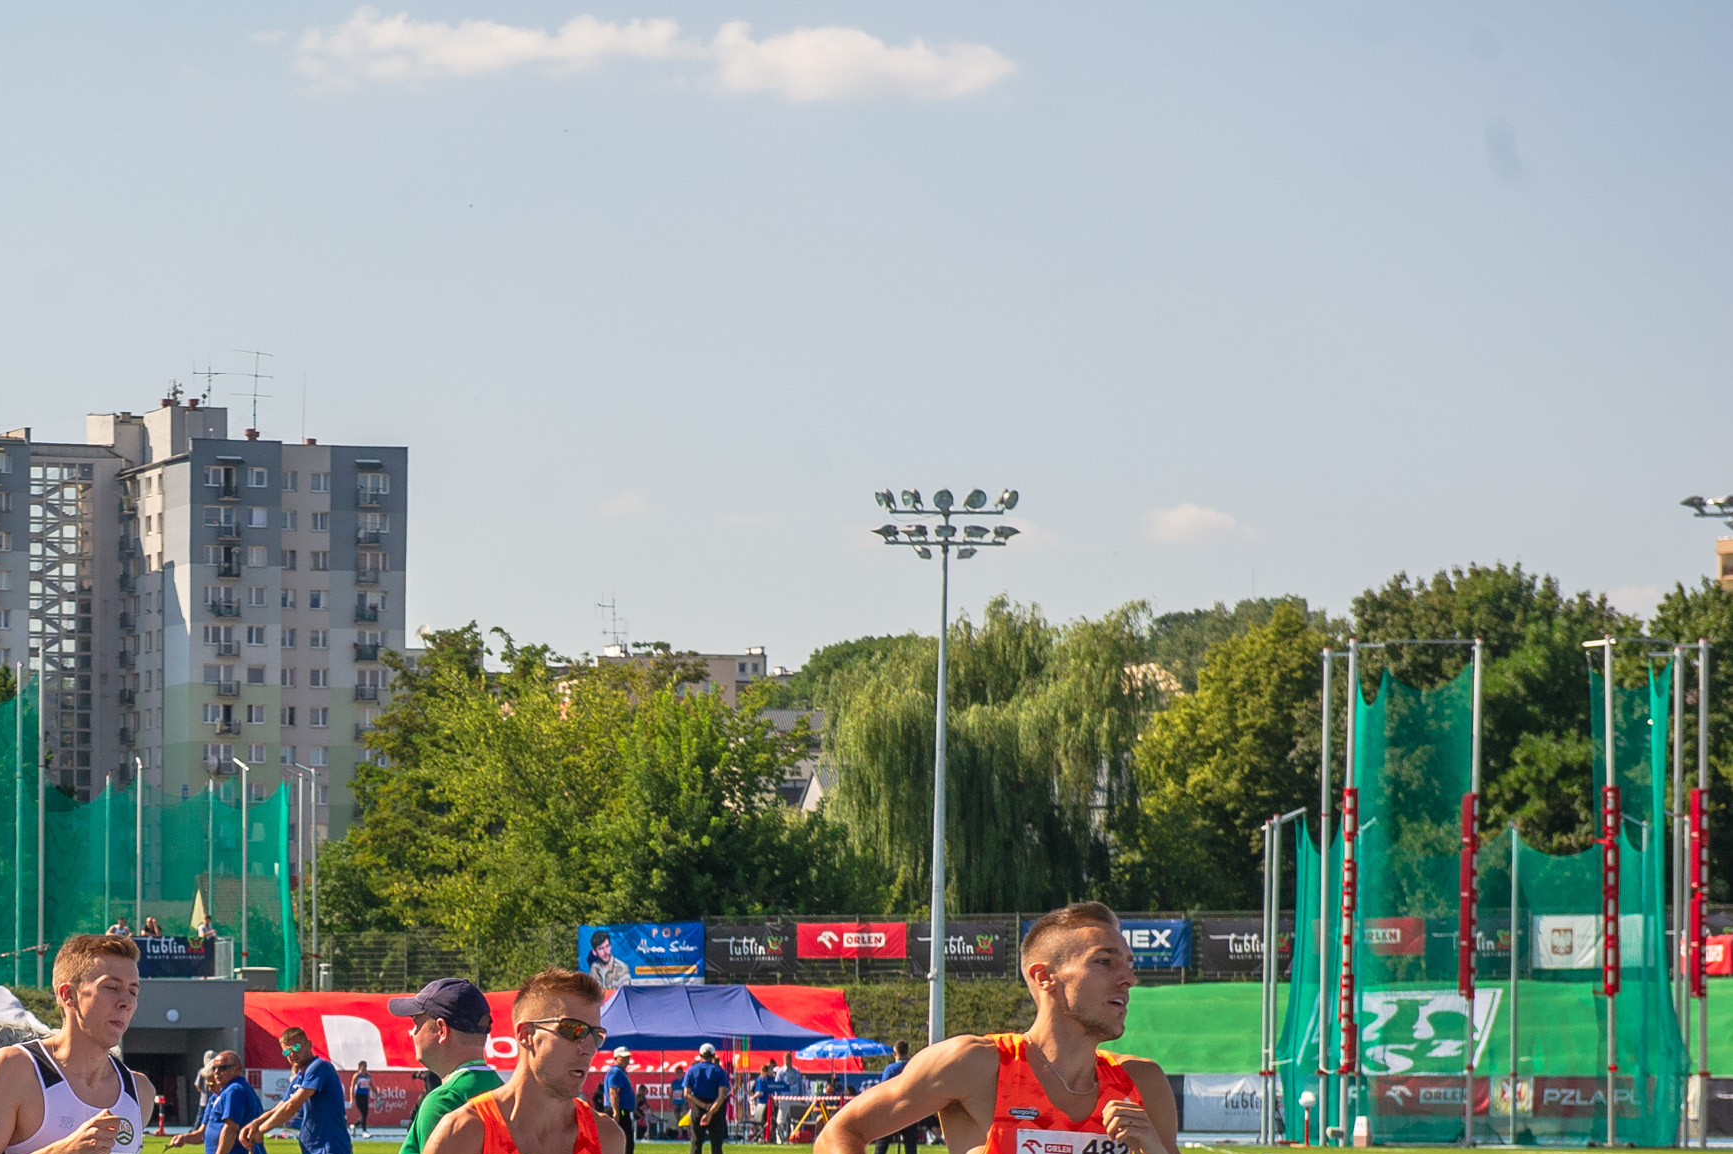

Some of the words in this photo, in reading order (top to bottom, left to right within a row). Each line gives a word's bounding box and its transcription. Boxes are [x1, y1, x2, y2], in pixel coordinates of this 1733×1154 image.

[845, 934, 883, 945] ORLEN
[1367, 930, 1397, 942] RLEN
[146, 936, 186, 954] lublin
[728, 936, 766, 956] lublin
[370, 1087, 407, 1099] elskie
[1046, 1144, 1072, 1154] ORLEN
